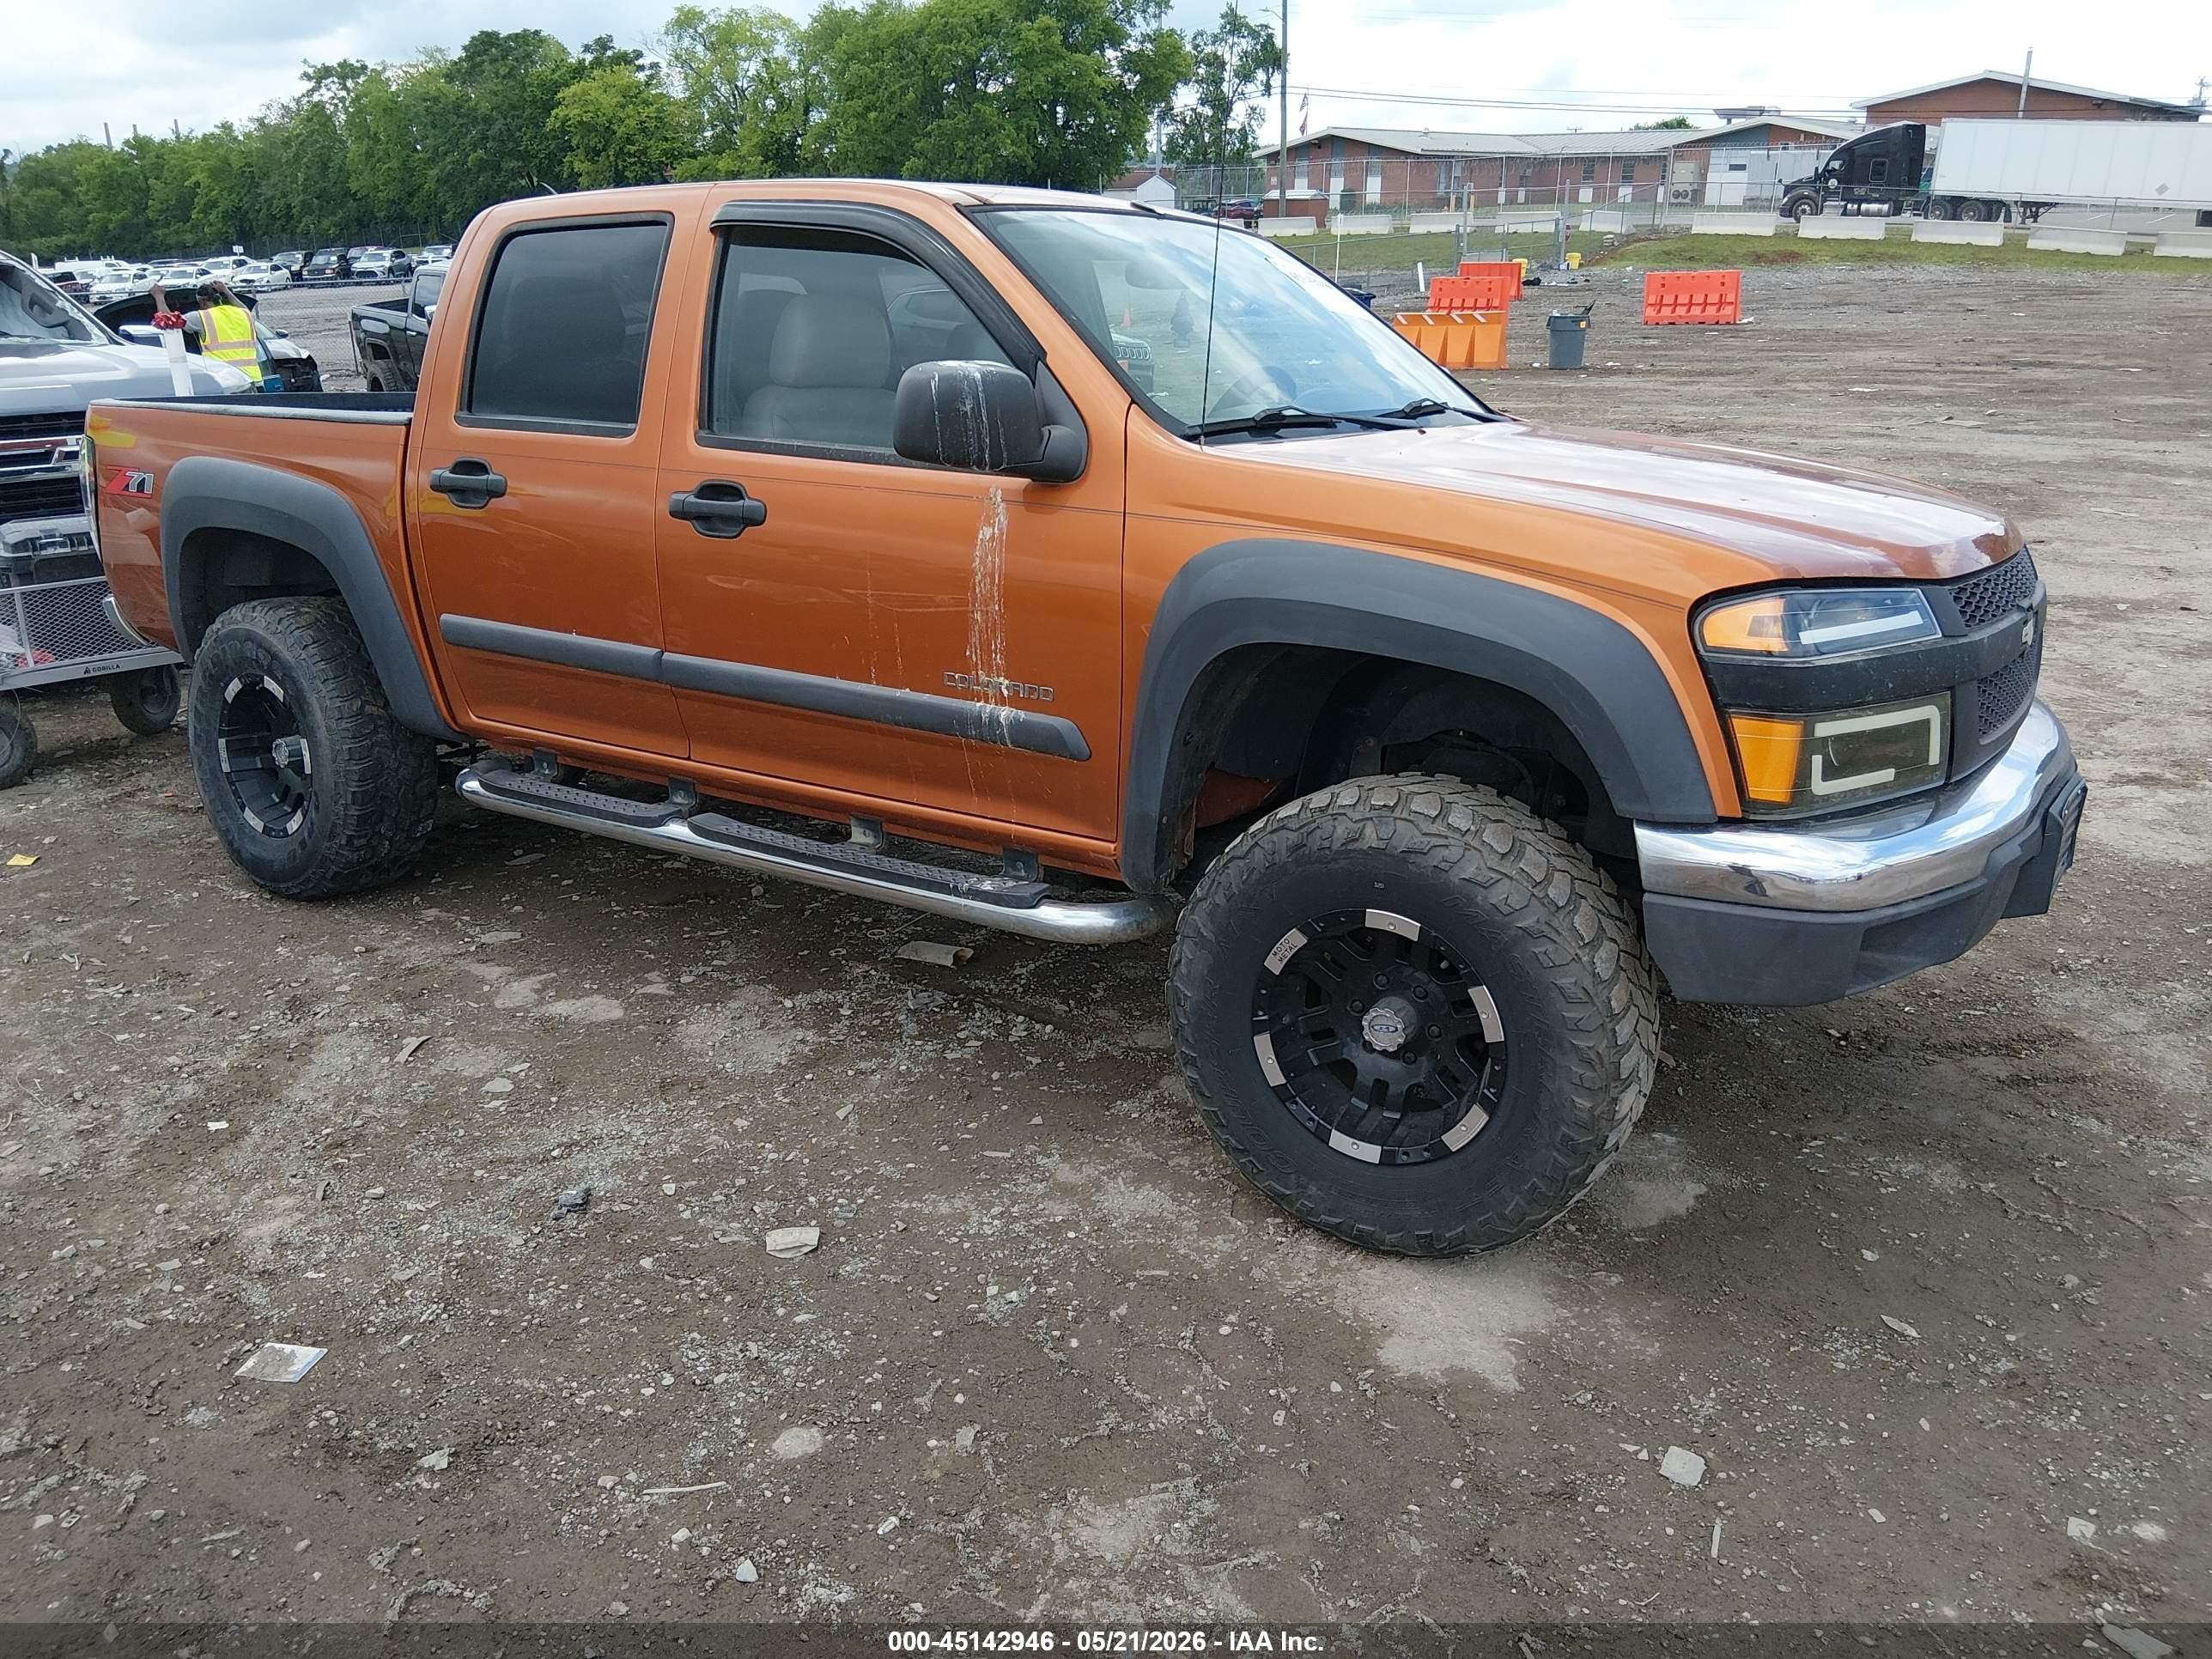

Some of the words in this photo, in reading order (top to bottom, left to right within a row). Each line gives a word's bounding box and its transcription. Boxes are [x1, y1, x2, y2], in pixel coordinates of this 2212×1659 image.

[100, 465, 154, 499] Z71
[943, 672, 1054, 702] COLORADO
[1271, 938, 1290, 957] MOTO
[1278, 943, 1298, 963] METAL
